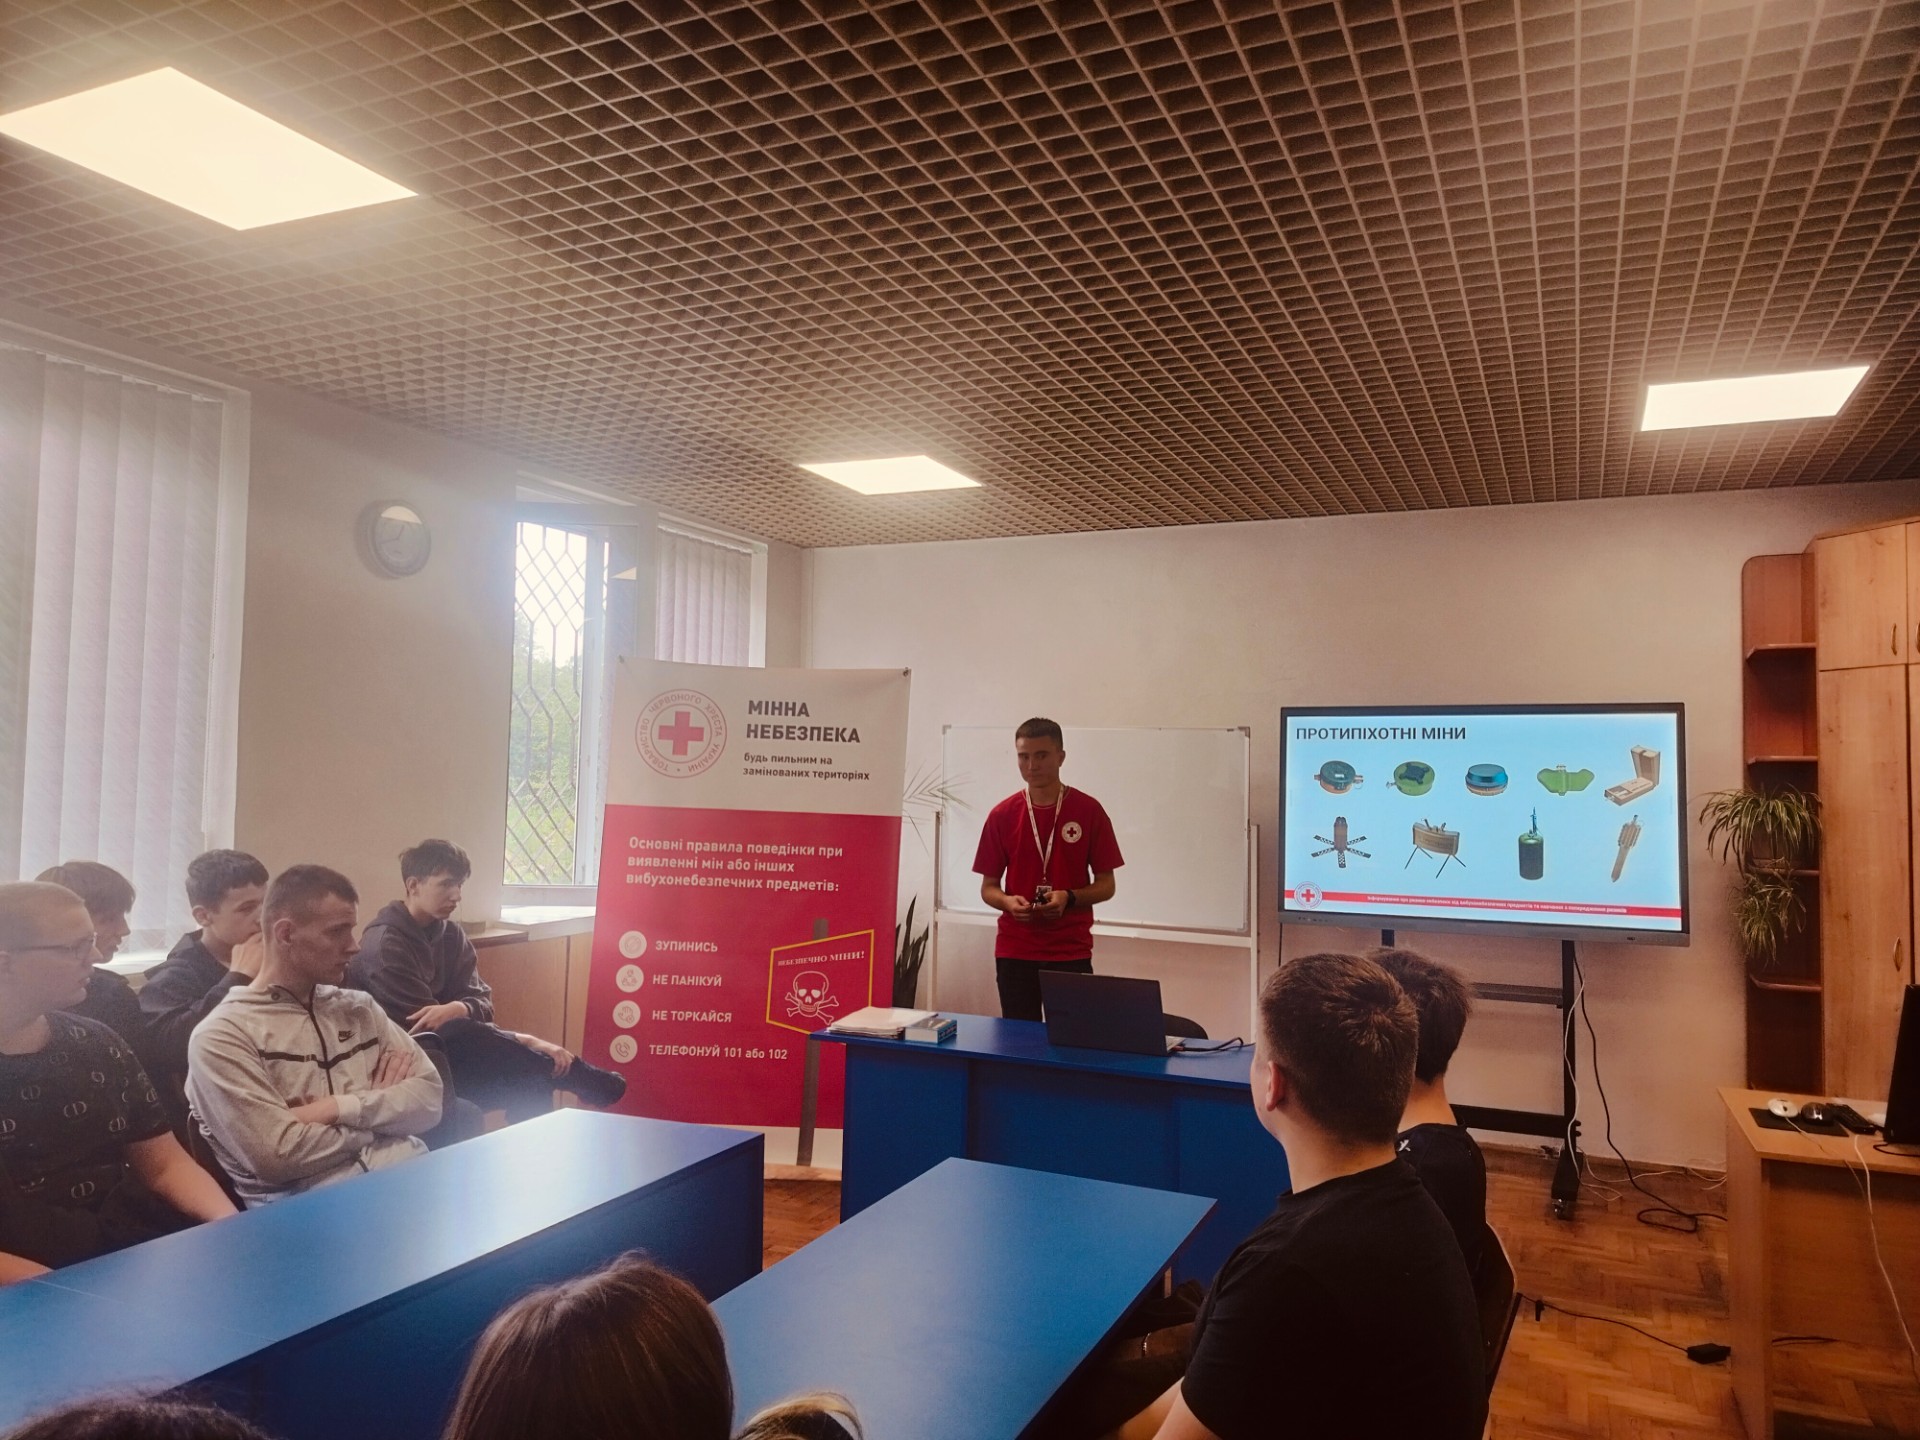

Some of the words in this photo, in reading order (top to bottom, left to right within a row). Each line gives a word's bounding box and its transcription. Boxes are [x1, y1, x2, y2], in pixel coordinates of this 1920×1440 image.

[648, 693, 702, 713] ЧЕРВОНОГО
[748, 700, 810, 717] МІННА
[704, 703, 723, 737] ХРЕСТА
[746, 723, 861, 743] НЕБЕЗПЕКА
[1296, 727, 1416, 740] ПРОТИПІХОТНІ
[1421, 727, 1466, 740] МІНИ
[640, 718, 669, 772] ТОВАРИСТВО
[688, 743, 720, 772] УКРАЇНИ
[744, 752, 768, 763] будь
[771, 755, 817, 764] пильним
[820, 756, 833, 765] на
[743, 767, 810, 778] замінованих
[812, 770, 870, 781] територіях
[629, 836, 683, 850] Основні
[687, 841, 743, 854] правила
[747, 843, 815, 856] поведінки
[818, 847, 843, 859] при
[627, 856, 698, 869] виявленні
[701, 857, 724, 870] мін
[727, 858, 751, 871] або
[754, 859, 795, 872] інших
[626, 872, 763, 888] вибухонебезпечних
[766, 879, 839, 892] предметів:
[655, 940, 718, 953] ЗУПИНИСЬ
[829, 950, 865, 962] МІНИ!
[652, 974, 668, 985] НЕ
[671, 974, 722, 987] ПАНІКУЙ
[652, 1010, 668, 1021] НЕ
[670, 1009, 732, 1023] ТОРКАЙСЯ
[649, 1044, 720, 1057] ТЕЛЕФОНУЙ
[723, 1047, 742, 1058] 101
[745, 1048, 765, 1059] або
[768, 1048, 788, 1060] 102
